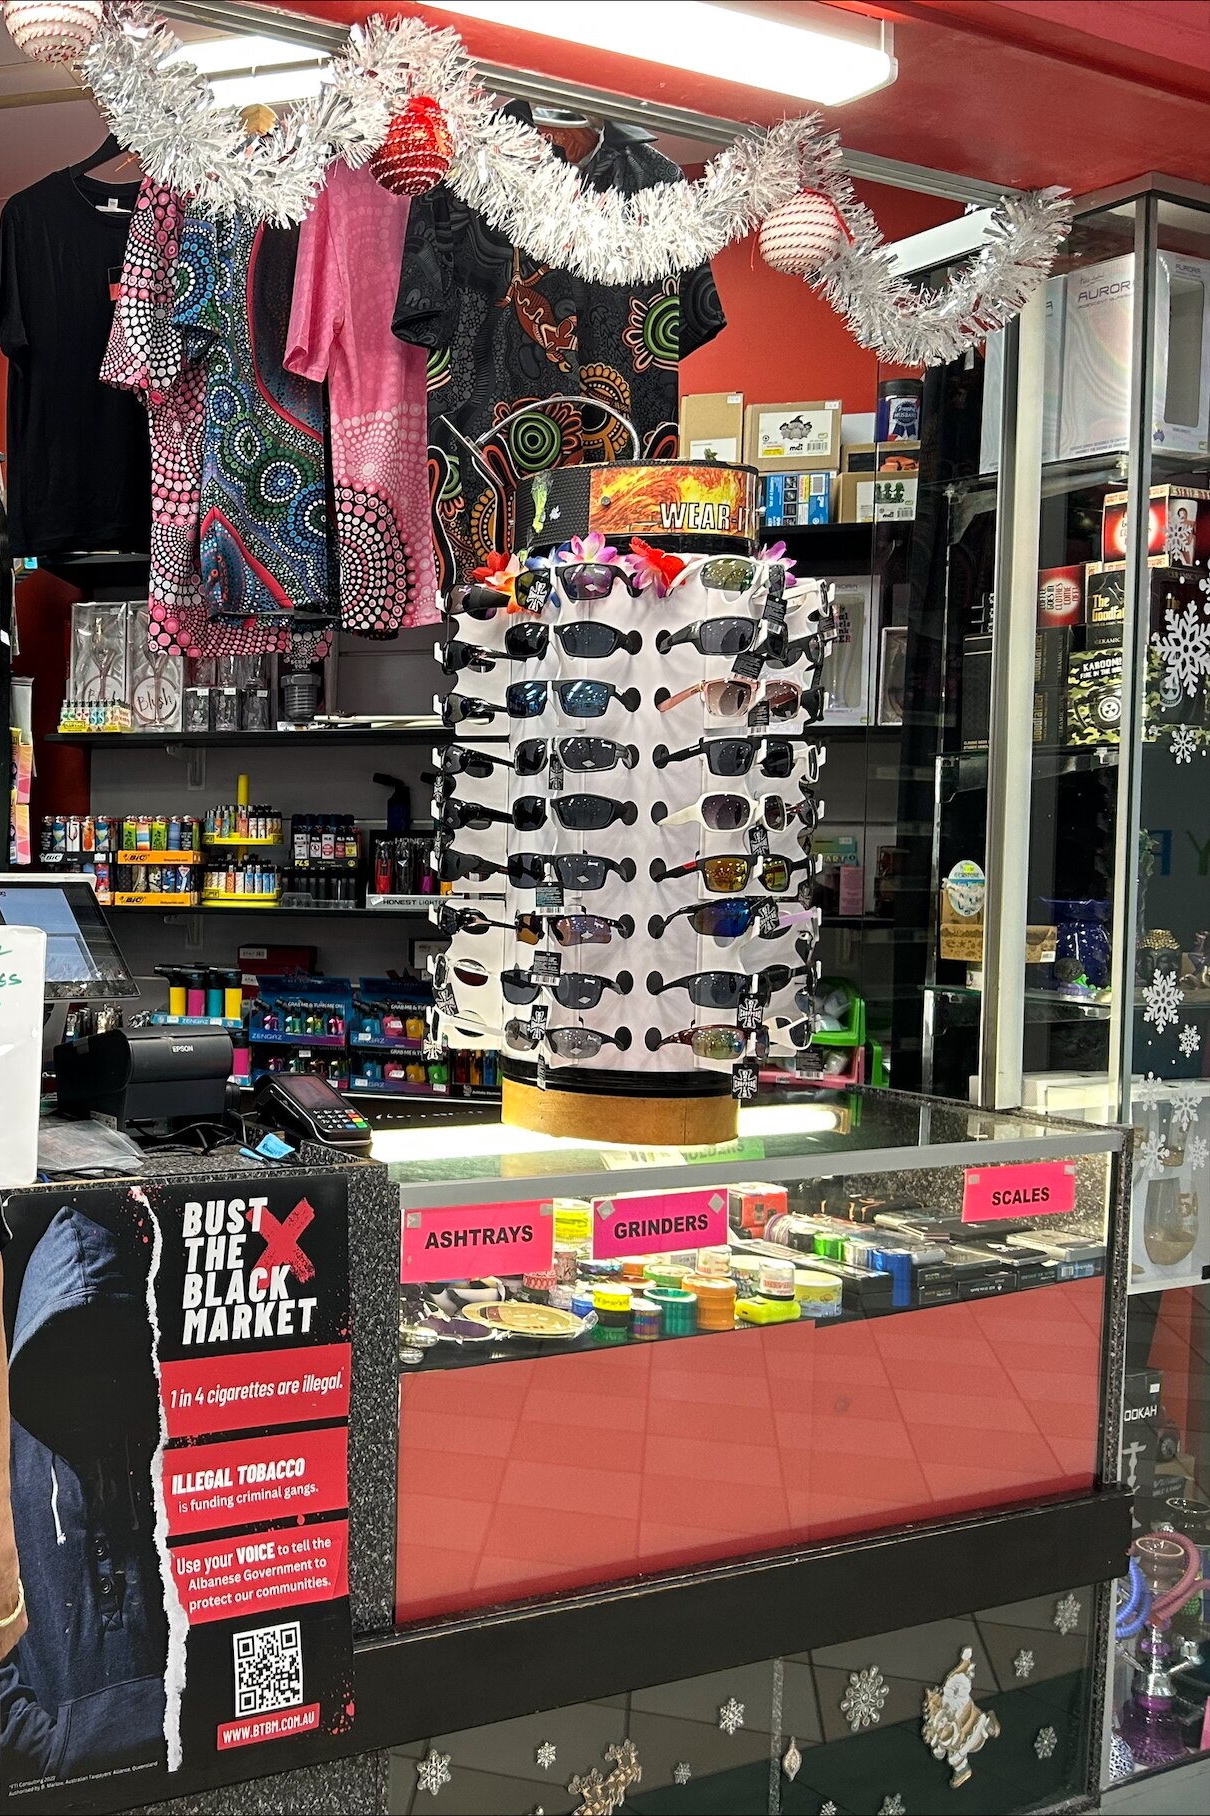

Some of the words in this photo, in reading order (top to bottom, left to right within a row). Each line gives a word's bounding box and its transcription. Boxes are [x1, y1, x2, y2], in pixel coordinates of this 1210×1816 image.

[1078, 280, 1134, 302] AUROR
[1092, 594, 1110, 608] The
[1092, 605, 1125, 622] Goodfa
[1082, 657, 1122, 672] KABOOM!
[172, 1045, 193, 1053] EPSON
[991, 1185, 1050, 1207] SCALES
[182, 1197, 268, 1238] BUST
[613, 1214, 709, 1240] GRINDERS
[184, 1234, 247, 1272] THE
[424, 1223, 534, 1250] ASHTRAYS
[182, 1265, 291, 1310] BLACK
[182, 1297, 318, 1345] MARKET
[170, 1390, 178, 1409] 1
[179, 1388, 193, 1407] in
[195, 1386, 205, 1405] 4
[207, 1380, 275, 1407] cigarettes
[276, 1379, 300, 1396] are
[302, 1371, 344, 1396] illegal.
[1124, 1405, 1157, 1421] OOKAH
[171, 1466, 234, 1495] ILLEGAL
[237, 1457, 306, 1486] TOBACCO
[178, 1499, 189, 1513] is
[190, 1493, 235, 1512] funding
[236, 1485, 283, 1505] criminal
[284, 1481, 319, 1500] gangs.
[176, 1556, 202, 1576] Use
[204, 1550, 234, 1575] your
[236, 1541, 276, 1565] VOICE
[277, 1543, 290, 1557] to
[291, 1538, 311, 1555] tell
[312, 1537, 332, 1551] the
[188, 1571, 241, 1591] Albanese
[243, 1560, 310, 1582] Government
[314, 1557, 327, 1569] to
[188, 1592, 233, 1613] protect
[234, 1588, 254, 1603] our
[255, 1575, 332, 1599] communities.
[222, 1710, 316, 1744] WWW.BTBM.COM.AU
